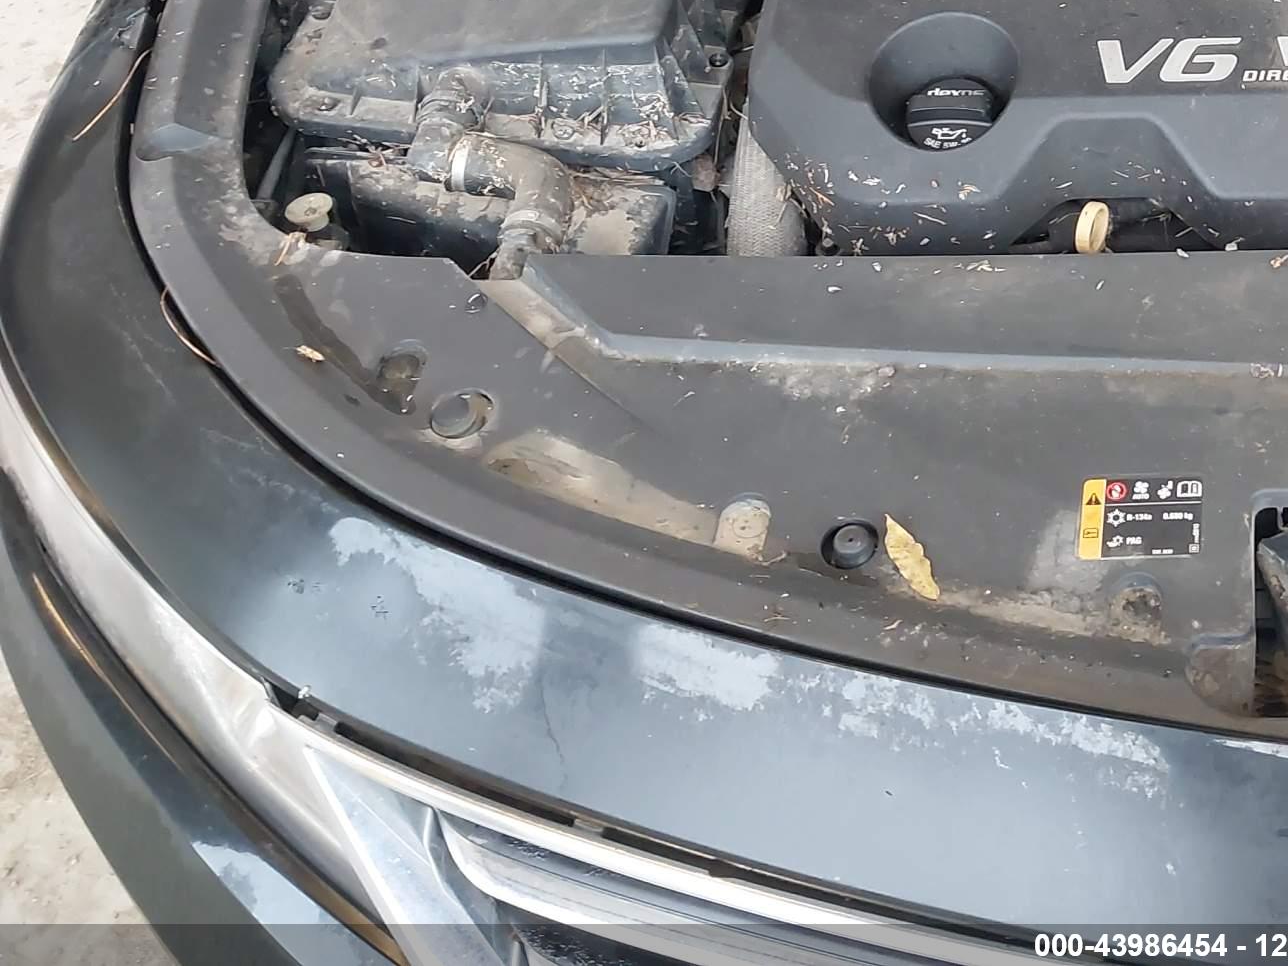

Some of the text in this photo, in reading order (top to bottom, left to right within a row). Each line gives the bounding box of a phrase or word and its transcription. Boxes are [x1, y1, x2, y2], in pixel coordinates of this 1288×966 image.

[1096, 37, 1243, 84] V6
[923, 137, 942, 149] SAE
[1126, 537, 1143, 546] PAG
